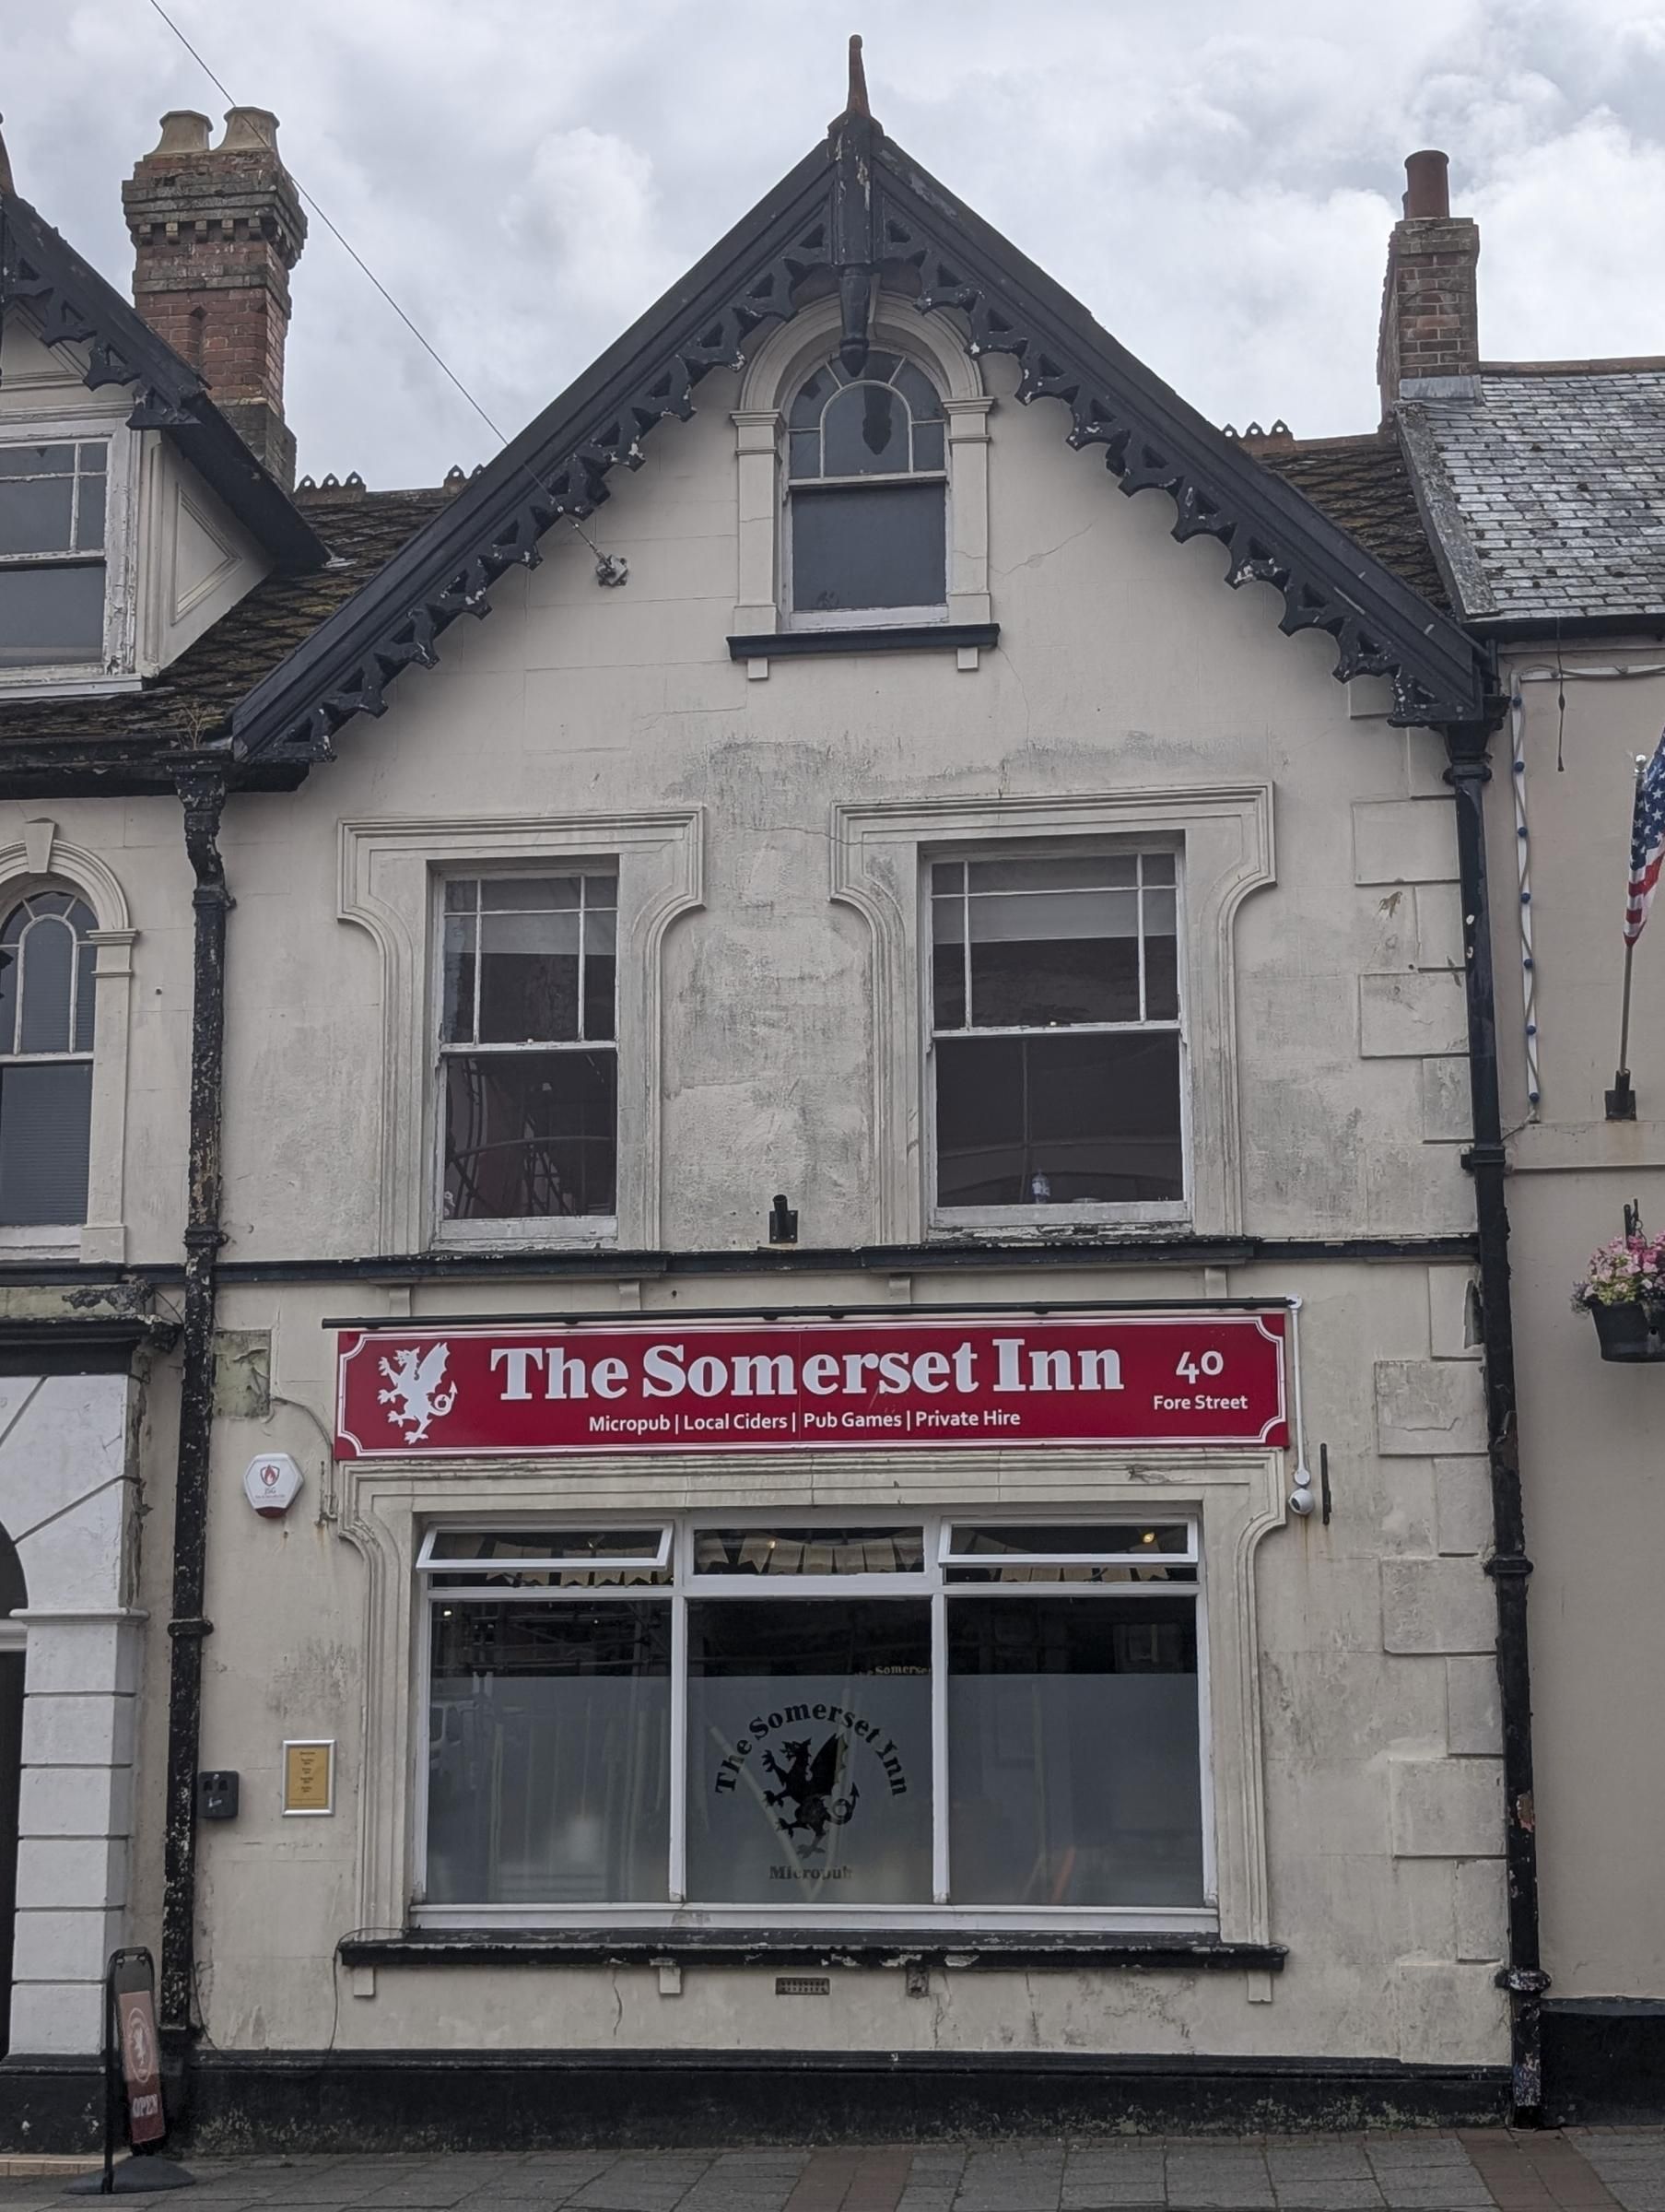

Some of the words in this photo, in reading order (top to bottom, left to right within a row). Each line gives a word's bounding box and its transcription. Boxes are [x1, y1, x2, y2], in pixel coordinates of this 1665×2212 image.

[490, 1346, 629, 1401] The
[641, 1342, 980, 1399] Somerset
[991, 1338, 1125, 1393] Inn
[1175, 1350, 1224, 1384] 40
[1154, 1394, 1191, 1410] Fore
[1194, 1394, 1249, 1410] Street
[589, 1414, 671, 1436] Micropub
[684, 1413, 730, 1430] Local
[733, 1412, 788, 1430] Ciders
[803, 1411, 838, 1429] Pub
[841, 1411, 902, 1429] Games
[916, 1410, 979, 1428] Private
[983, 1410, 1021, 1426] Hire
[714, 1738, 753, 1794] The
[748, 1702, 880, 1744] Somerset
[875, 1739, 908, 1796] Inn
[132, 2094, 158, 2118] OPEN
